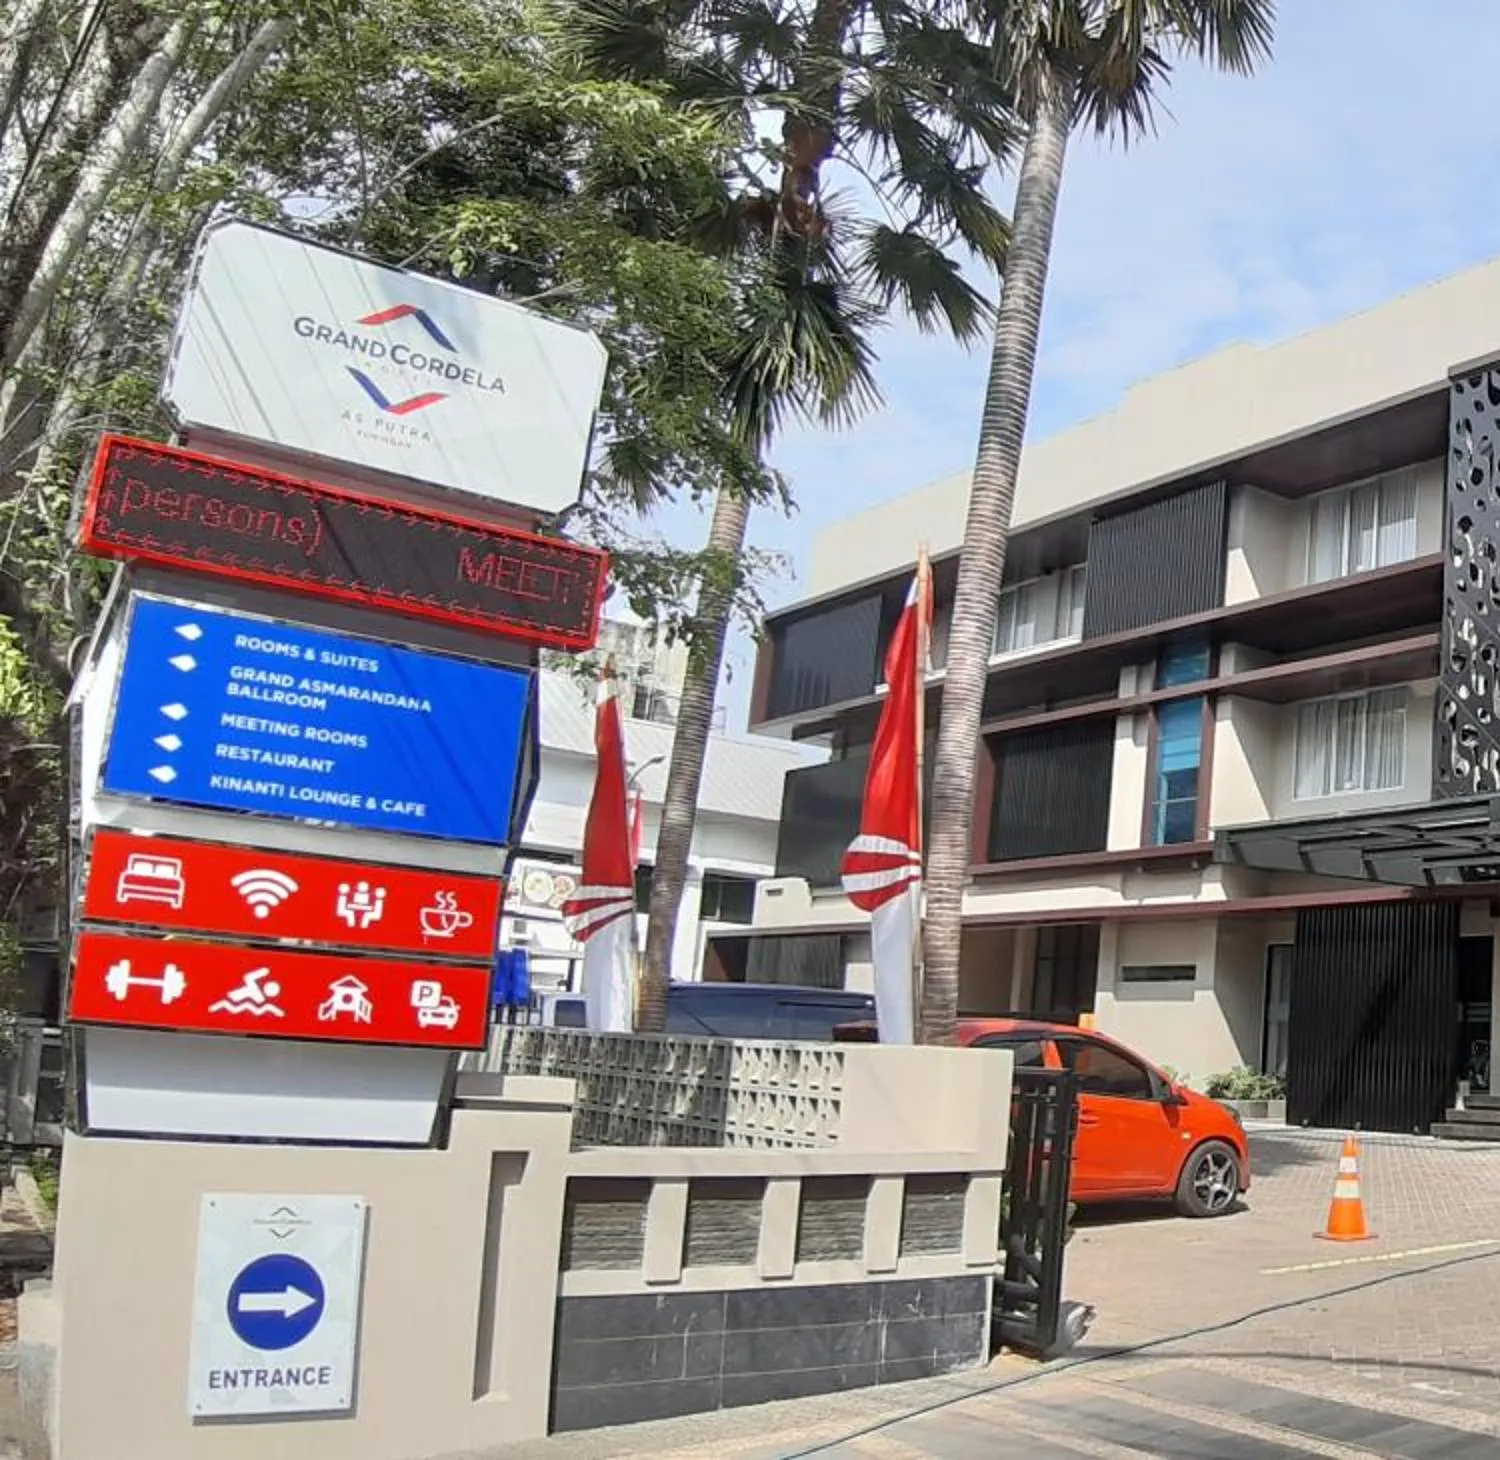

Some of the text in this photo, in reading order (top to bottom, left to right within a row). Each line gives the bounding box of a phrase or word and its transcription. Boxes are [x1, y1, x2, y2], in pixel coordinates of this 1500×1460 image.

[375, 417, 431, 442] PUTRA
[234, 633, 380, 673] ROOMS & SUITES
[226, 682, 327, 711] BALLROOM
[230, 665, 432, 713] GRAND ASMARANDANA
[220, 712, 369, 749] MEETING ROOMS
[215, 742, 336, 774] RESTAURANT
[210, 774, 429, 817] KINANTI LOUNGE & CAFE
[418, 985, 434, 1002] P
[208, 1365, 332, 1390] ENTRANCE
